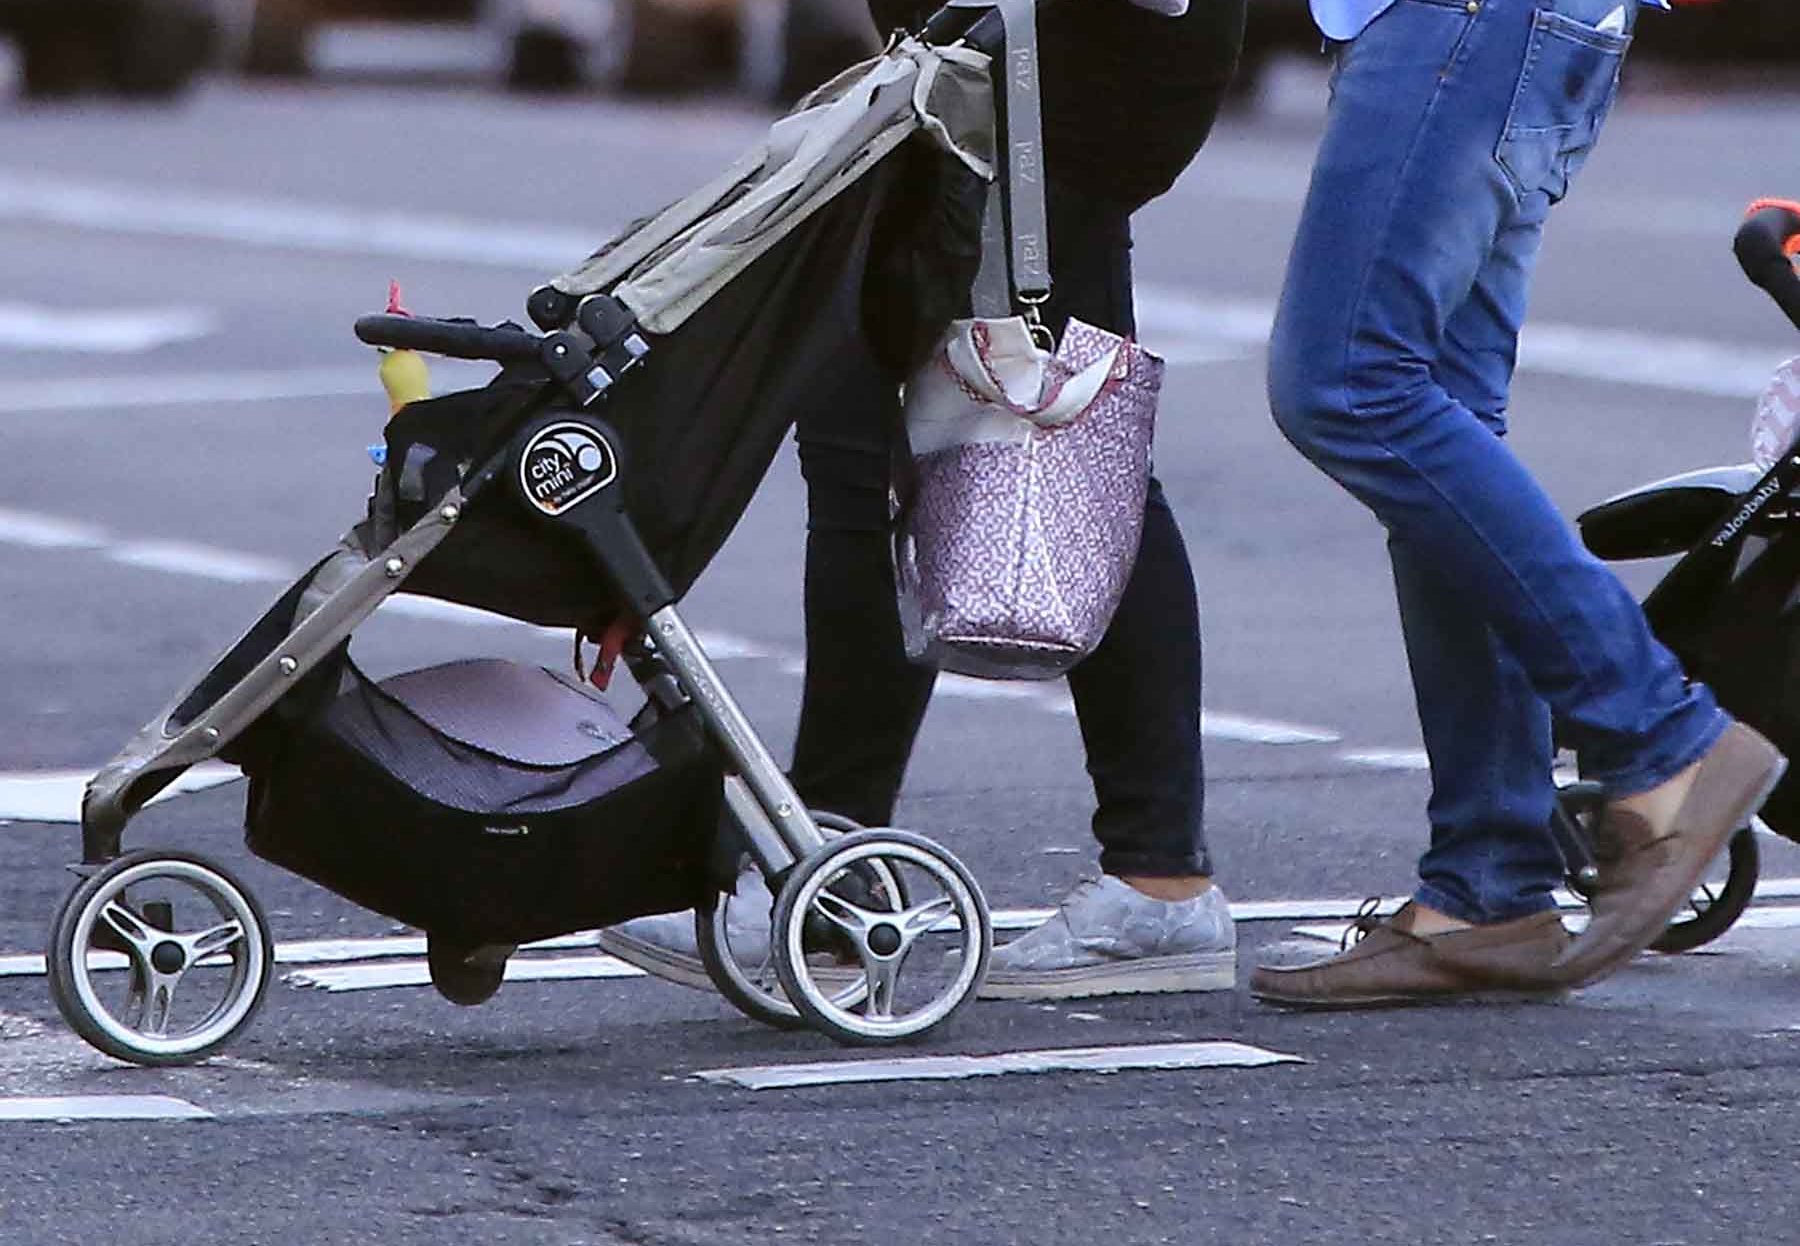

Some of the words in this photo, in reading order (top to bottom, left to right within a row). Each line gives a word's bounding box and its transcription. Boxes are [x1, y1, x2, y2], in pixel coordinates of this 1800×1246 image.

[1011, 48, 1031, 90] paz
[1015, 141, 1036, 183] paz
[1017, 234, 1040, 275] paz
[531, 453, 560, 479] city
[535, 464, 575, 498] mini
